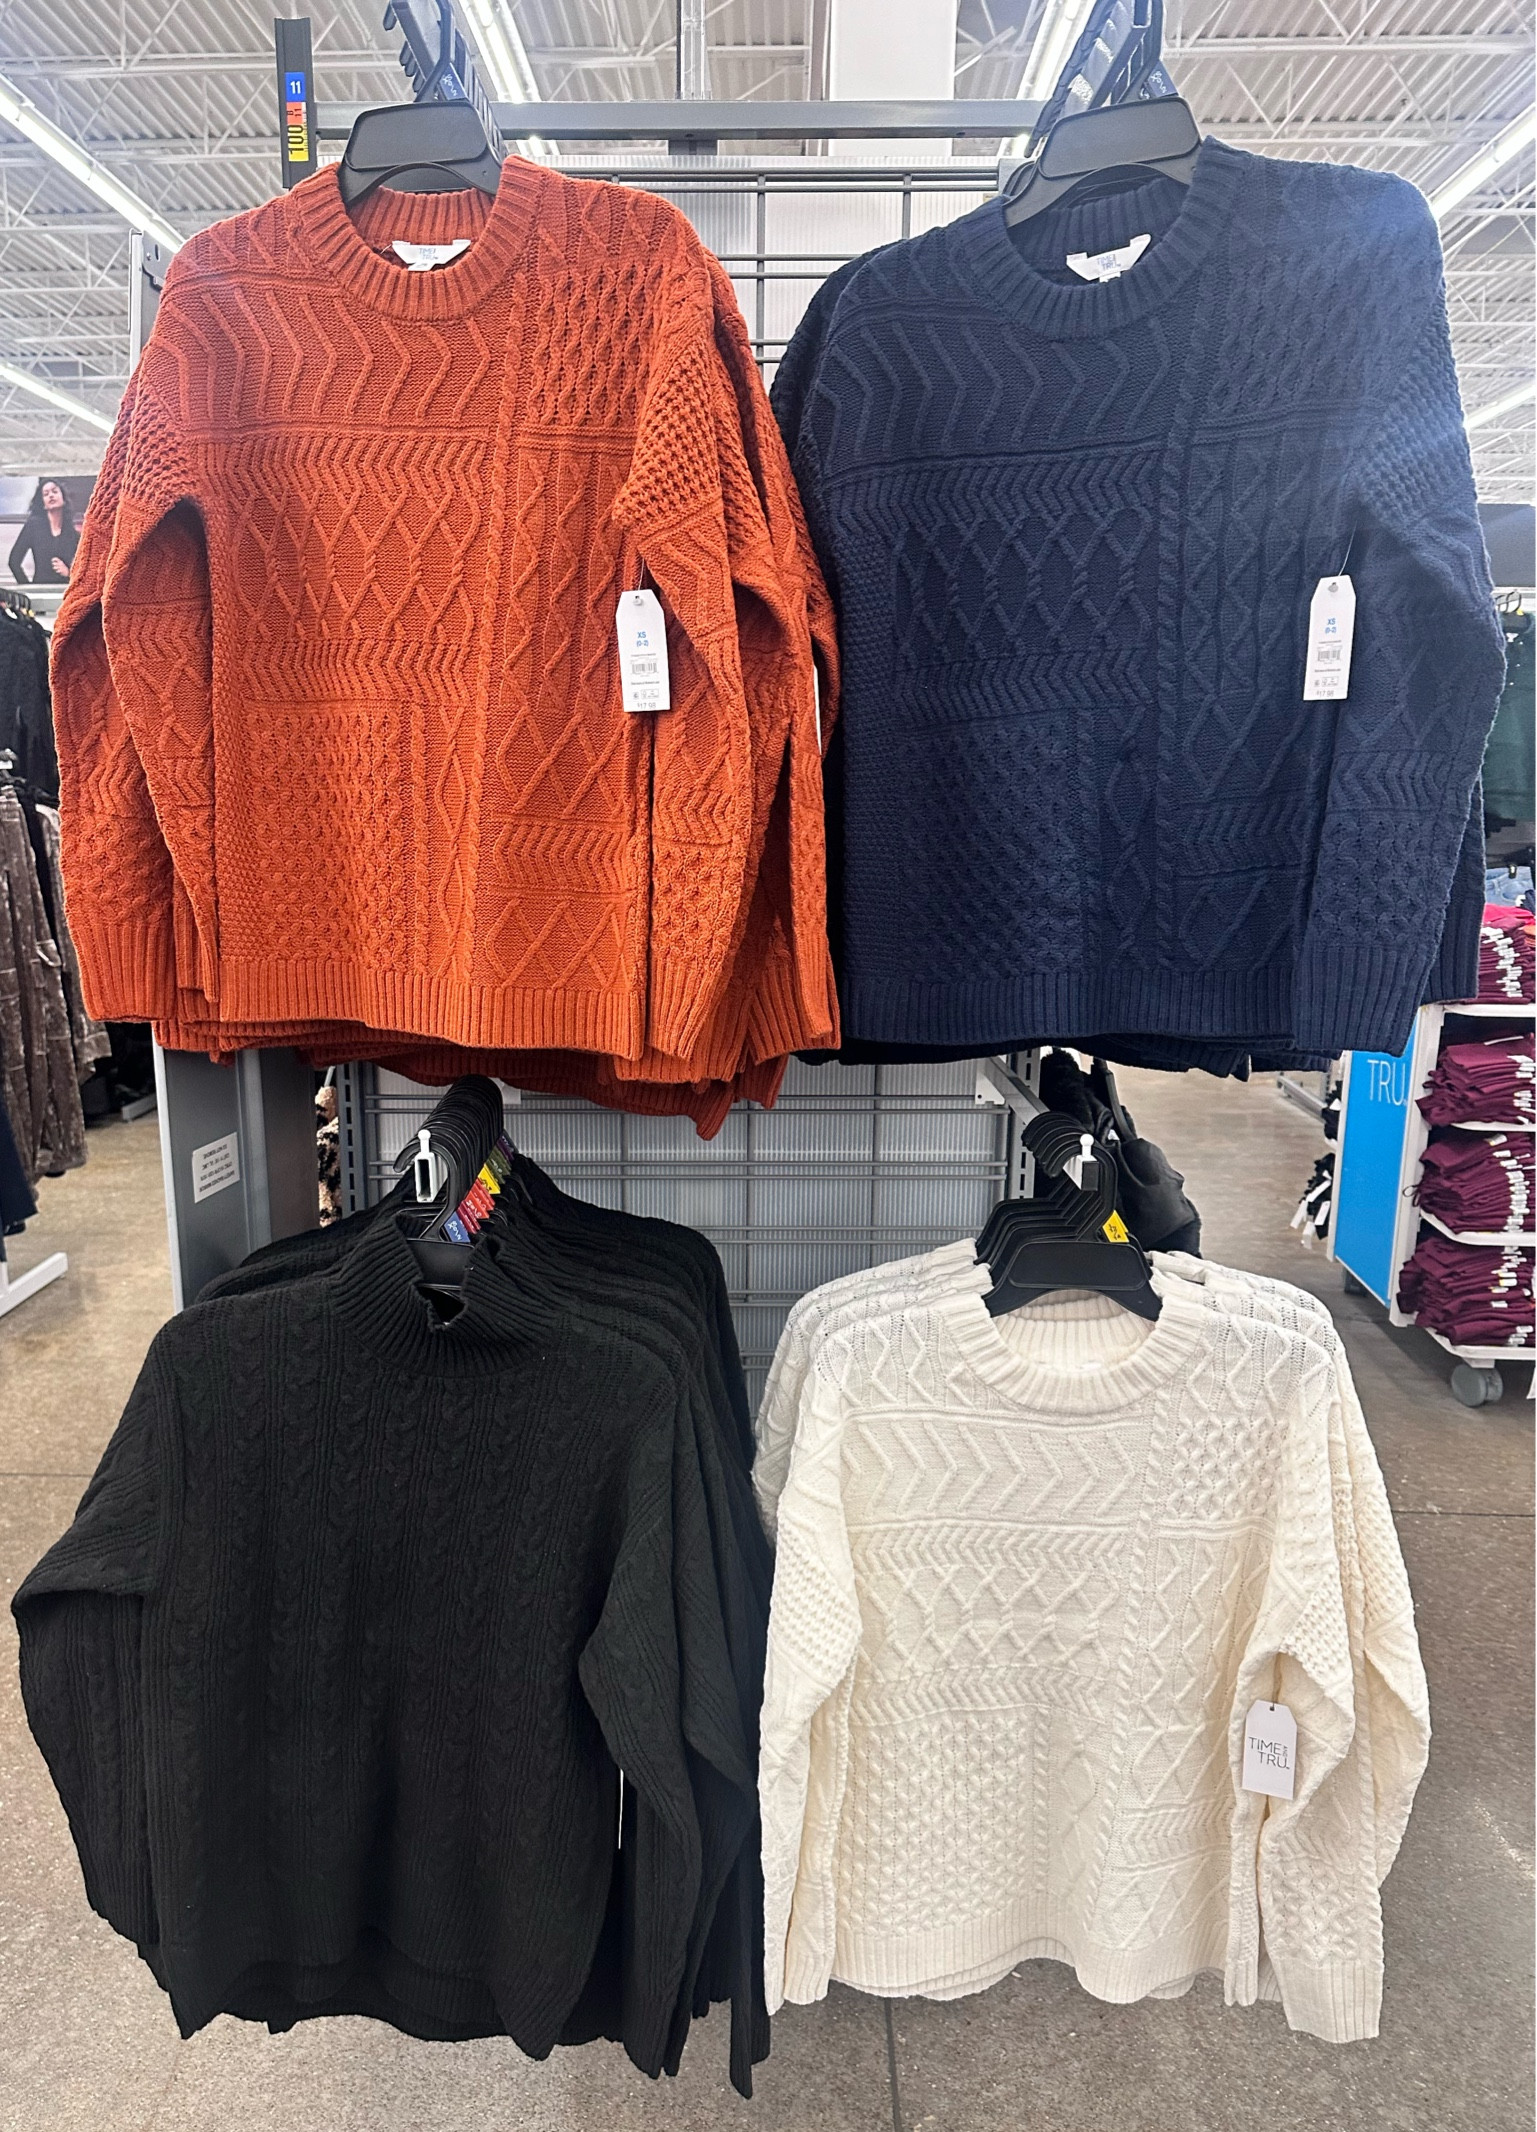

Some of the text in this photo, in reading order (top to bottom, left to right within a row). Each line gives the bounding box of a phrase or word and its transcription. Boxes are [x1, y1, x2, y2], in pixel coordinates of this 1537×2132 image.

[290, 81, 301, 94] 11
[288, 125, 304, 155] 100
[1327, 617, 1336, 626] XS
[637, 631, 647, 639] XS
[1248, 1736, 1282, 1756] TIME
